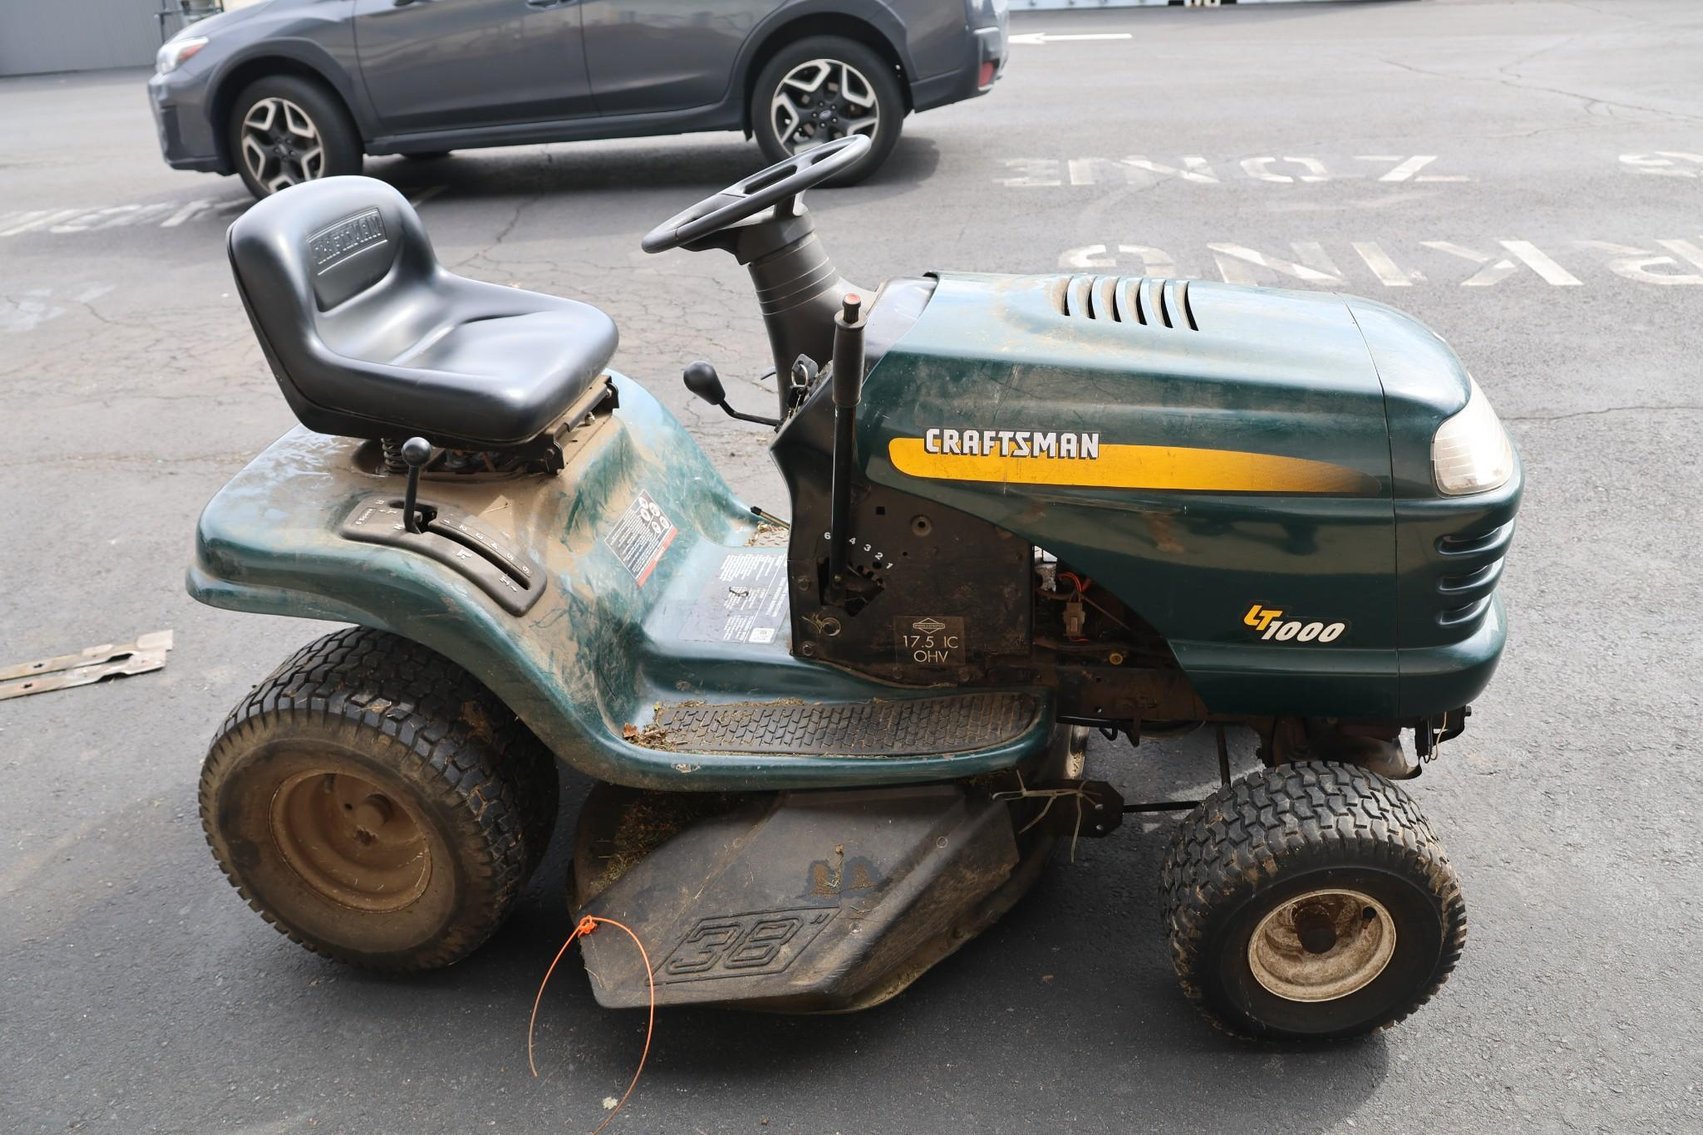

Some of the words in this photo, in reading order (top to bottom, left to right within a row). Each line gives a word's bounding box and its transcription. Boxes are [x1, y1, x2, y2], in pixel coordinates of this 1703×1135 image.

[994, 155, 1470, 187] ZONE
[924, 428, 1101, 460] CRAFTSMAN
[823, 531, 832, 540] 6
[848, 537, 857, 545] 4
[863, 544, 872, 552] 3
[874, 551, 884, 560] 2
[886, 562, 894, 570] 1
[902, 635, 935, 649] 17.5
[943, 636, 959, 649] IC
[913, 650, 949, 663] OHV
